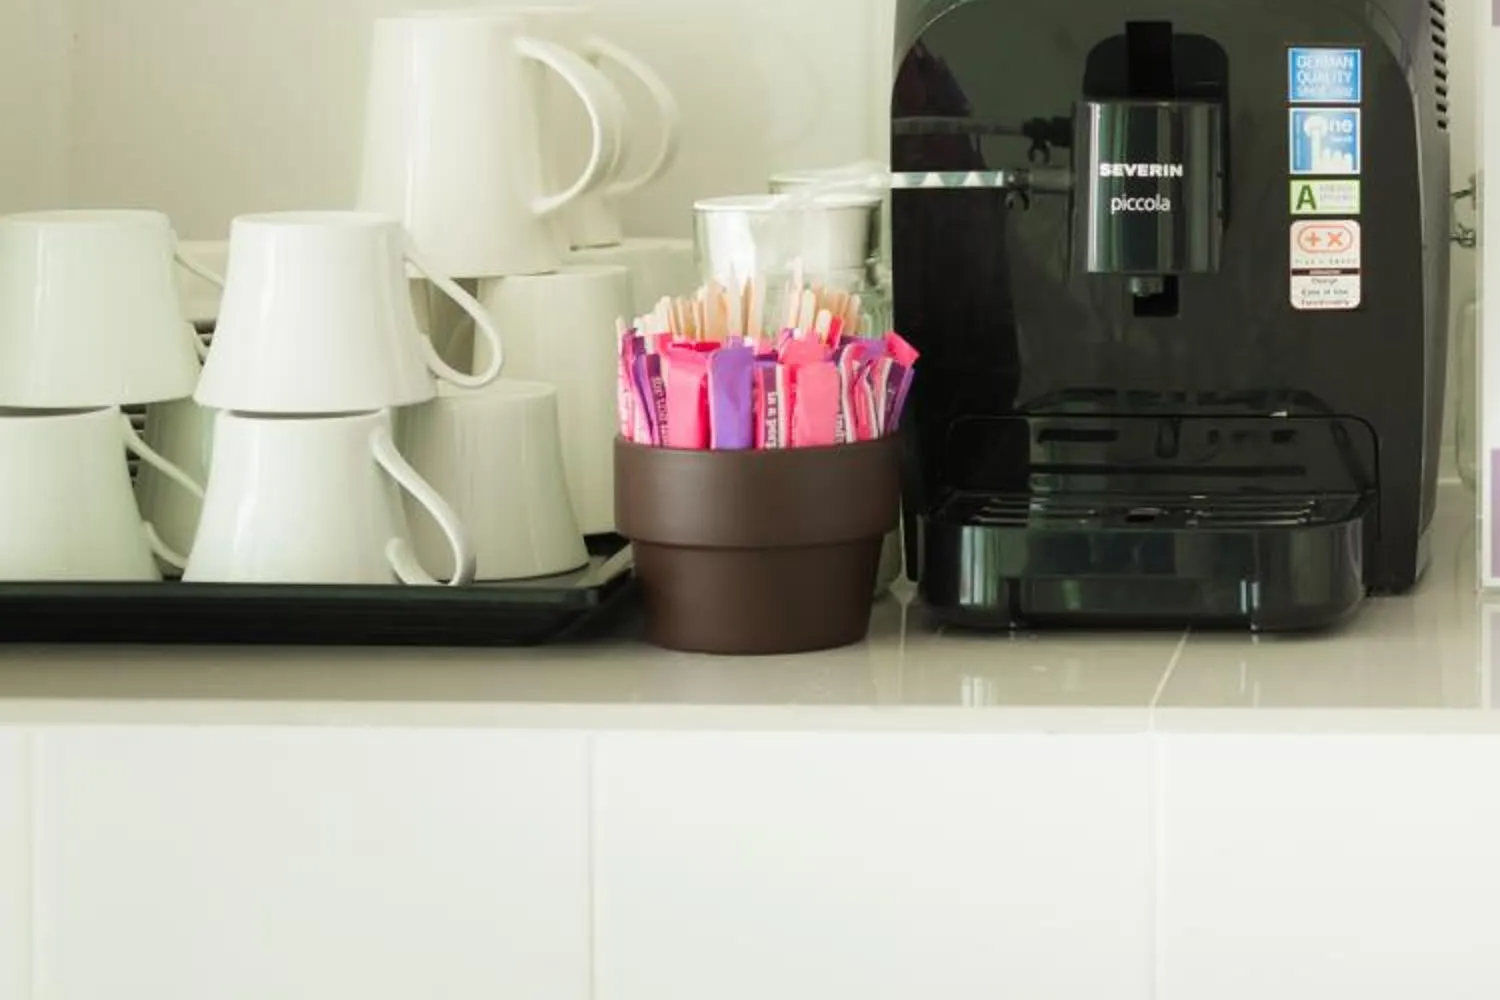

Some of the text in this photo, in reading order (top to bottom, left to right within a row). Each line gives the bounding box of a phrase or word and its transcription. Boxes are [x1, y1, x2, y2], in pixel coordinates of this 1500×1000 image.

[1099, 162, 1184, 177] SEVERIN
[1110, 192, 1171, 216] piccola
[1296, 184, 1317, 210] A
